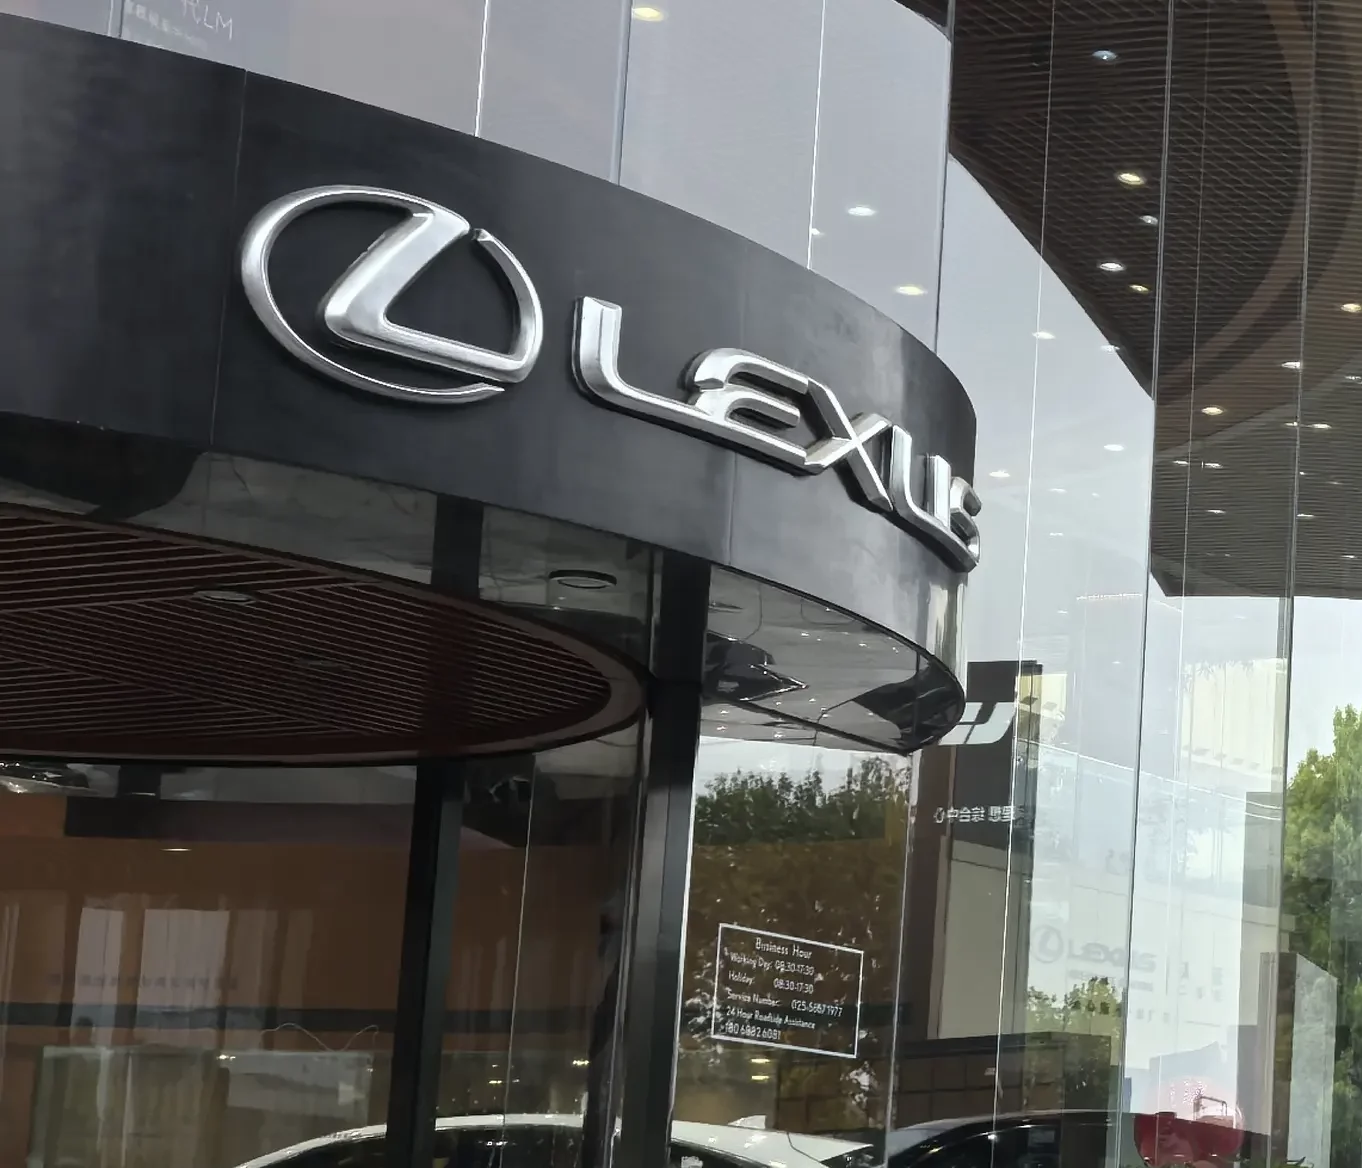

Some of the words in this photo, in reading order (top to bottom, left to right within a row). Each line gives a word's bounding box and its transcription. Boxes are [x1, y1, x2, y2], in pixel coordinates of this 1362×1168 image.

[571, 295, 981, 573] LEXUS
[755, 937, 789, 954] Business
[793, 943, 812, 960] Hour
